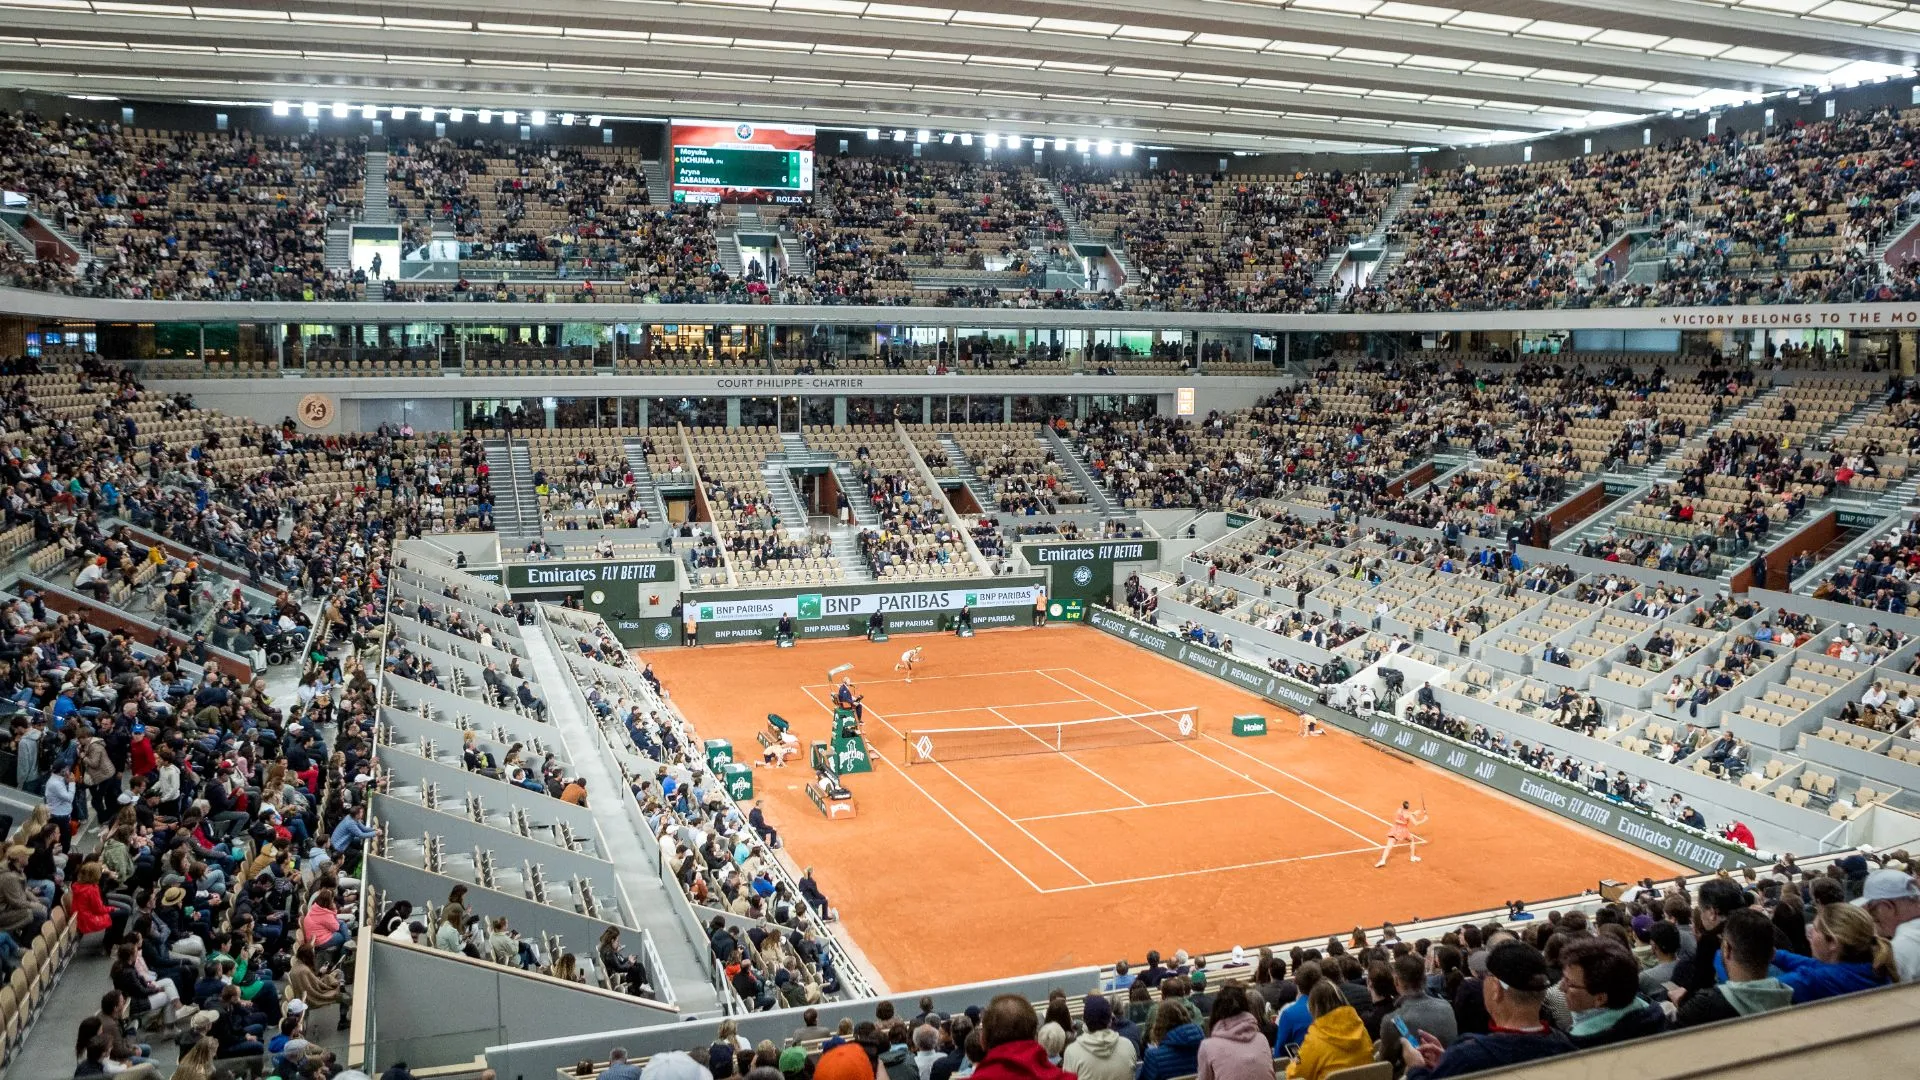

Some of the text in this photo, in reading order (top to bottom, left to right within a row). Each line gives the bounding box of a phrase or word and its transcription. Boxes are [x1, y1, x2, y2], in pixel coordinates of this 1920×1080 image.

[680, 168, 700, 176] Aryna
[680, 176, 720, 184] SABALENKA
[1673, 314, 1733, 324] VICTORY
[1742, 313, 1812, 324] BELONGS
[1820, 313, 1840, 323] TO
[1849, 312, 1881, 323] THE
[717, 379, 752, 388] COURT
[756, 379, 802, 387] PHILIPPE
[812, 379, 863, 388] CHATRIER
[1038, 544, 1143, 562] Emirates FLY BETTER
[528, 564, 656, 583] Emirates FLY BETTER
[980, 591, 1031, 601] BNP PARIBAS
[826, 592, 949, 614] BNP PARIBAS
[716, 603, 774, 614] BNP PARIBAS
[889, 619, 934, 628] BNP PARIBAS
[973, 614, 1016, 624] BNP PARIBAS
[732, 628, 763, 637] PARIBAS
[820, 623, 850, 632] PARIBAS
[1102, 617, 1167, 650] LACOSTE LACOSTE
[1188, 651, 1314, 707] RENAULT RENAULT RENAULT
[1243, 722, 1264, 732] Haier
[1520, 778, 1611, 825] Emirates FLY BETTER
[1617, 816, 1725, 869] Emirates FLY BETTER
